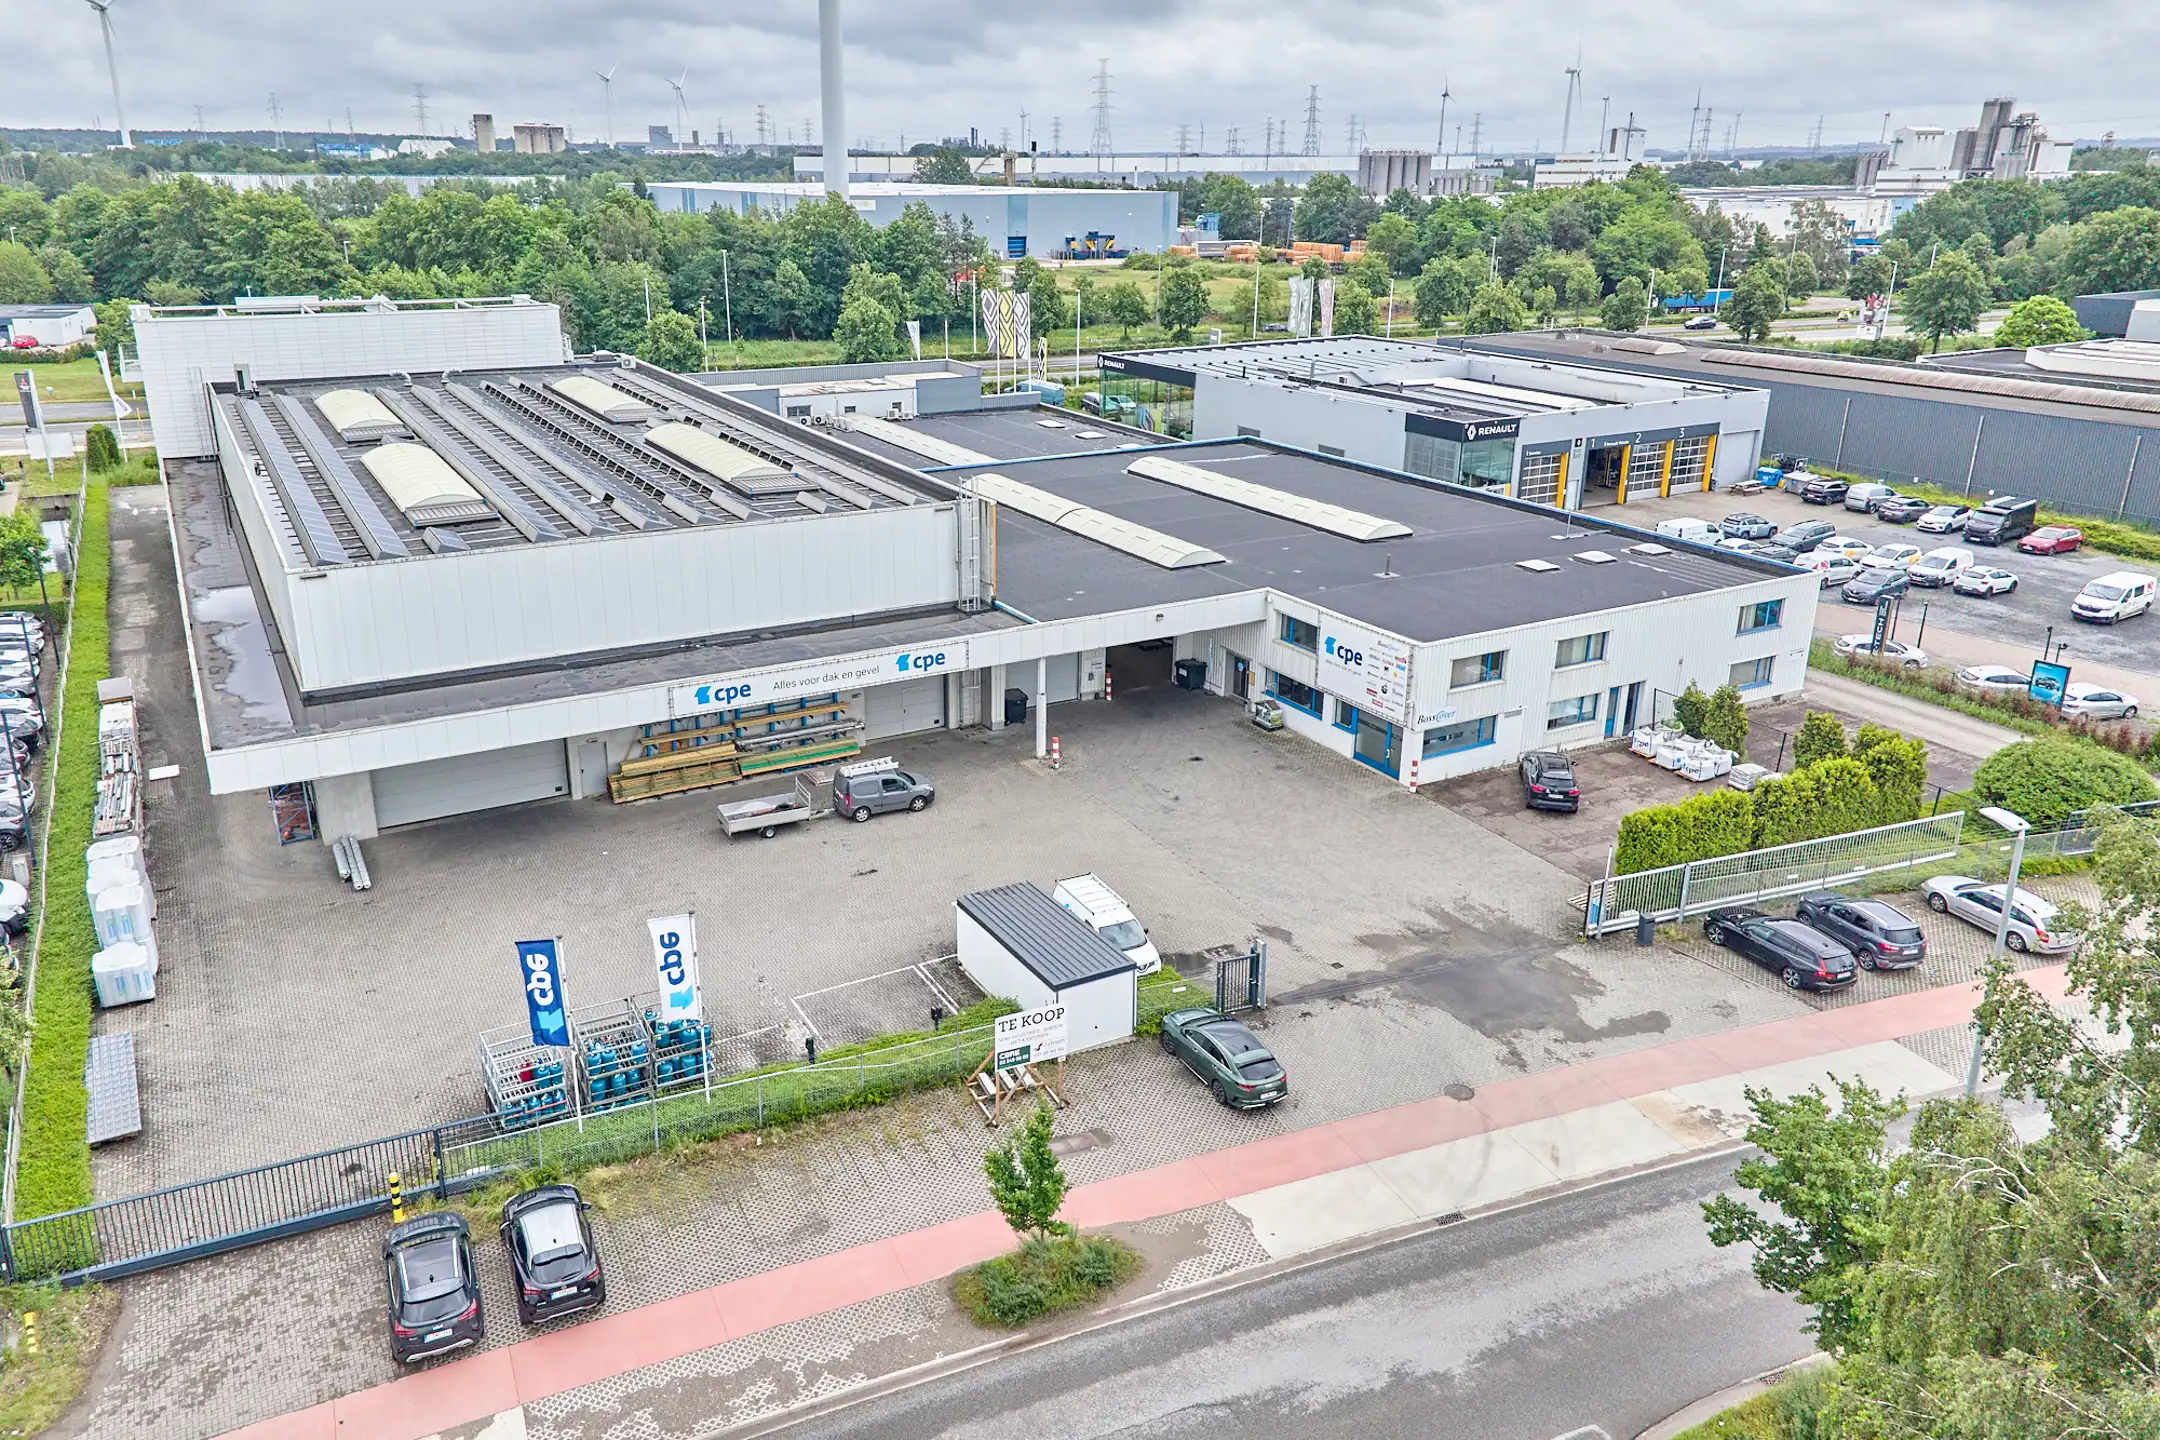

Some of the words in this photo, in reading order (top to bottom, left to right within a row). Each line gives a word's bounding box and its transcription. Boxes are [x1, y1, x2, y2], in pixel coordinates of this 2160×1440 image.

[1104, 360, 1125, 369] RENAULT
[1477, 423, 1517, 436] RENAULT
[1679, 427, 1685, 438] 3
[1591, 438, 1595, 448] 1
[1634, 432, 1641, 443] 2
[913, 653, 945, 671] cpe
[1337, 645, 1363, 666] cpe
[773, 678, 797, 691] Alles
[799, 675, 820, 686] voor
[822, 670, 839, 683] dak
[841, 671, 853, 680] en
[855, 665, 880, 681] gevel
[714, 683, 751, 704] cpe
[1685, 766, 1700, 774] cpe
[998, 1018, 1017, 1033] TE
[1021, 1007, 1065, 1027] KOOP
